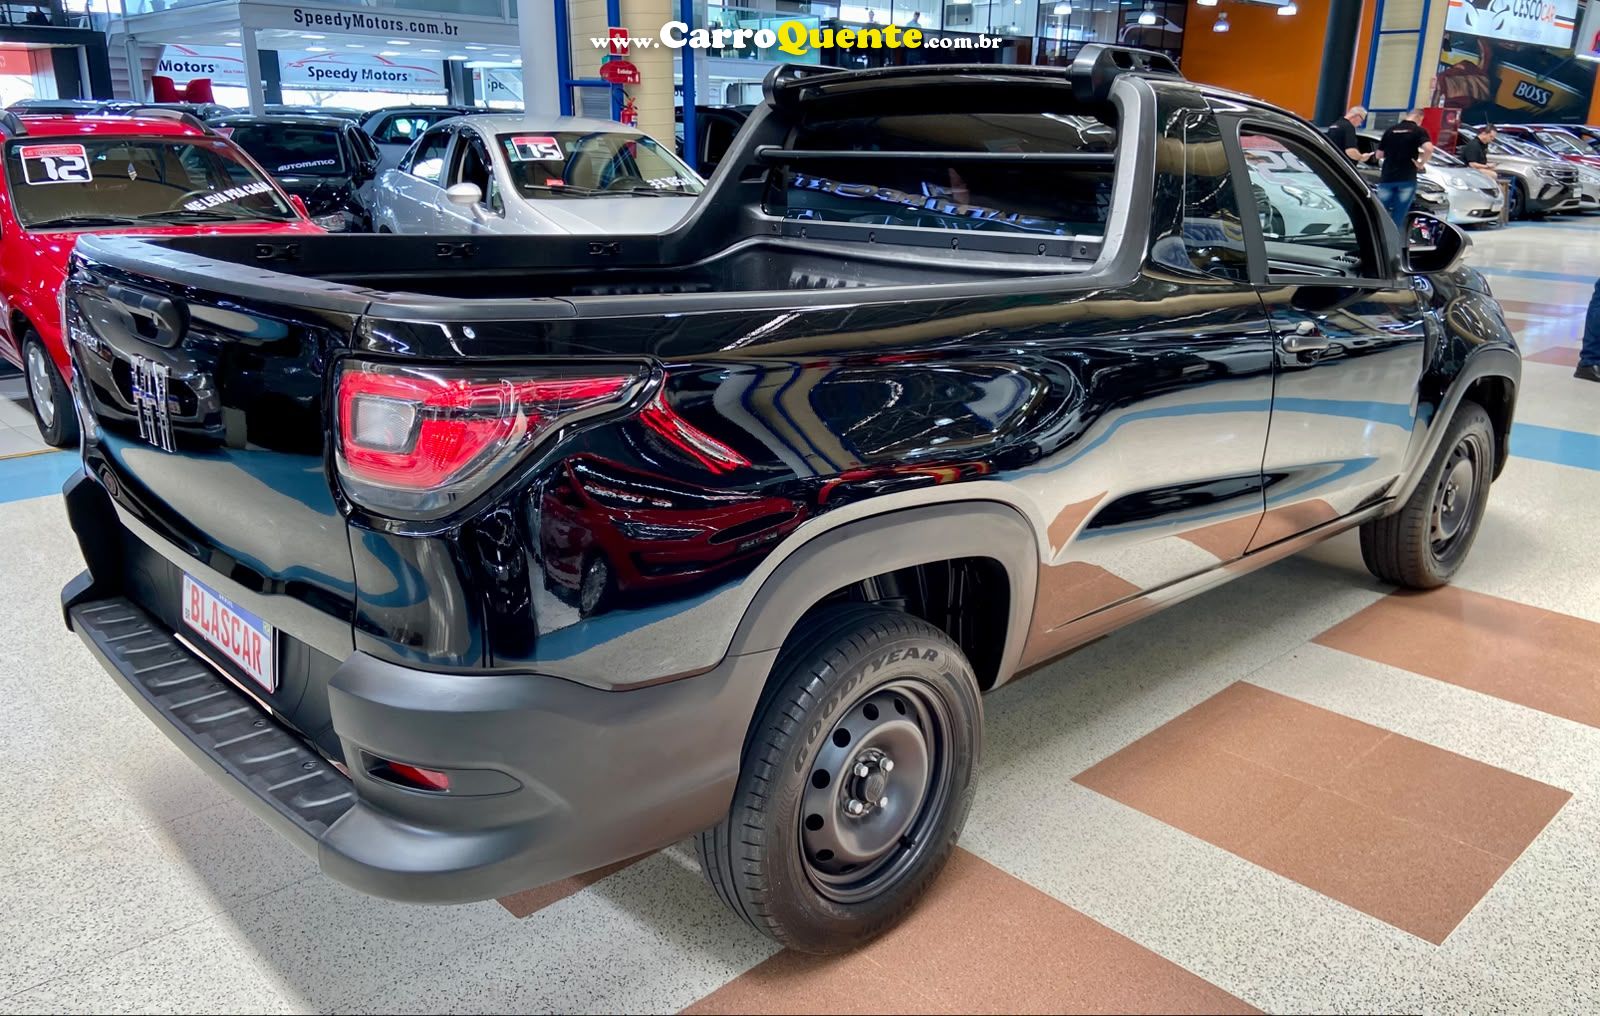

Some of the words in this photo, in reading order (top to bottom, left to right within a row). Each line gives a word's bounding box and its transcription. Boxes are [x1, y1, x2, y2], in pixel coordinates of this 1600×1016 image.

[294, 9, 458, 36] SpeedyMotors.com.br
[159, 60, 215, 73] Motors
[308, 66, 358, 82] Speedy
[361, 69, 408, 82] Motors
[1516, 81, 1549, 105] BOSS
[200, 192, 231, 207] LEVA
[224, 187, 249, 200] PRA
[191, 584, 262, 675] BLASCAR
[794, 647, 939, 774] GOODYEAR
